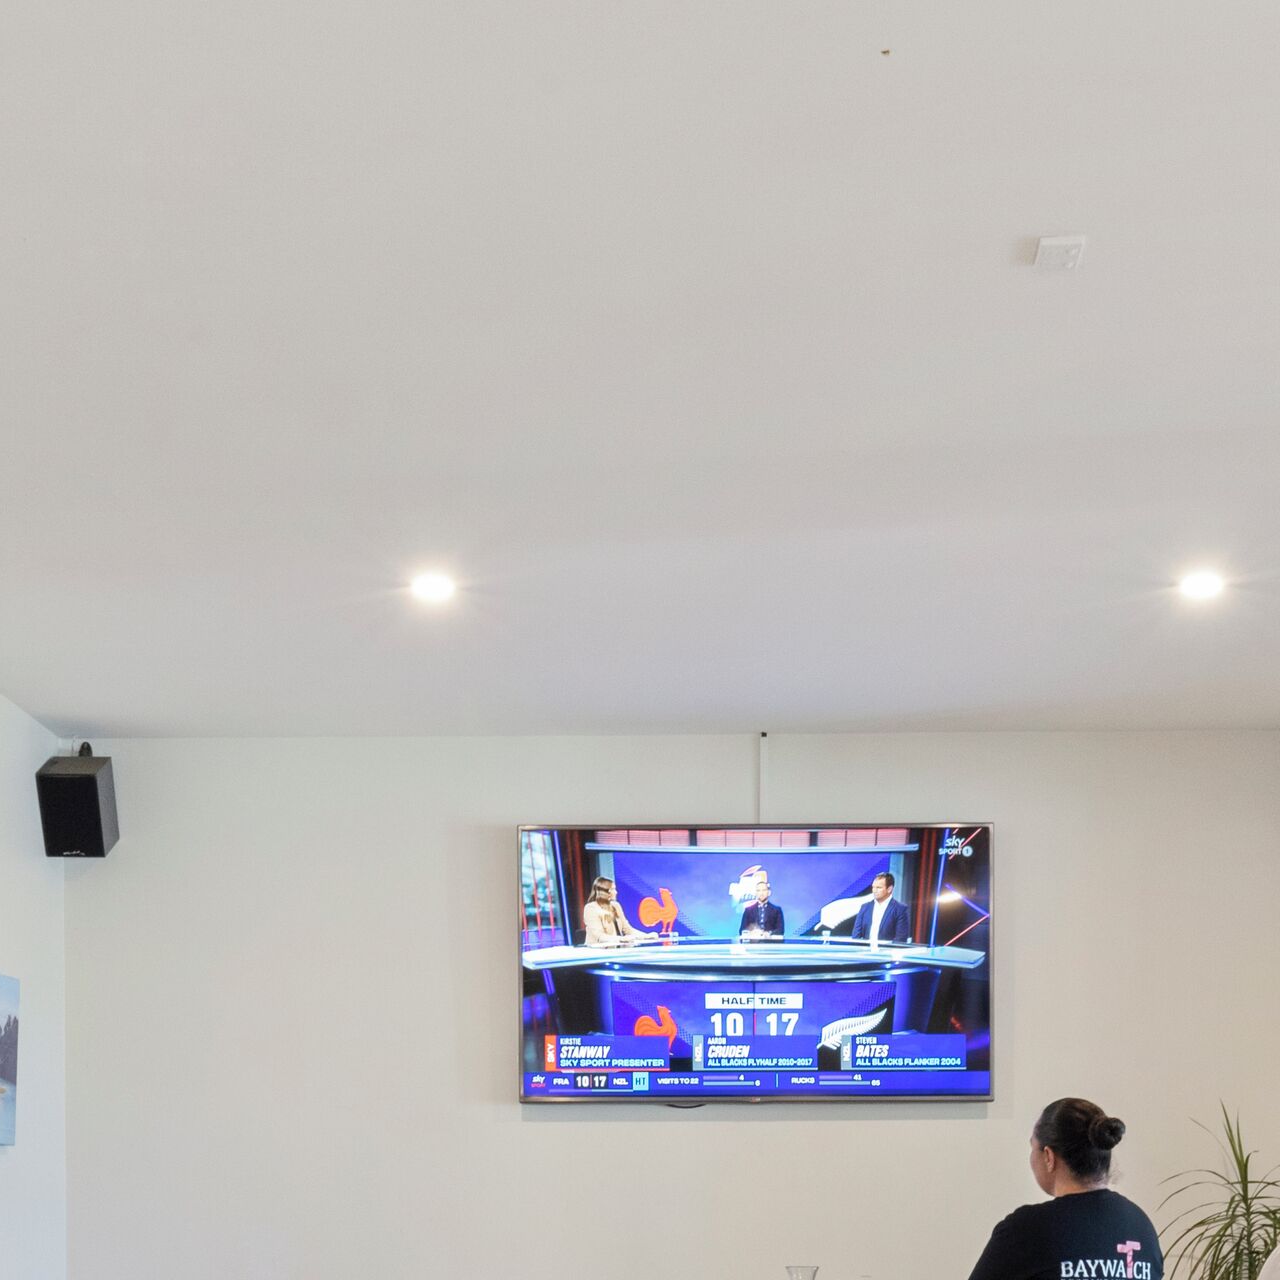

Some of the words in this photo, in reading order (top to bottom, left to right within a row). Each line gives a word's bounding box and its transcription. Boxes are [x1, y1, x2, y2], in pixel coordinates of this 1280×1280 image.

[945, 835, 965, 848] sky
[722, 997, 754, 1005] HALF
[759, 997, 787, 1005] TIME
[710, 1012, 744, 1036] 10
[766, 1012, 799, 1036] 17
[547, 1043, 555, 1063] SKY
[560, 1046, 610, 1058] STANWAY
[707, 1045, 750, 1058] CRUDEN
[856, 1045, 889, 1057] BATES
[560, 1059, 578, 1067] SKY
[580, 1059, 610, 1067] SPORT
[612, 1059, 665, 1067] PRESENTER
[707, 1058, 720, 1066] ALL
[721, 1058, 747, 1066] BLACKS
[748, 1058, 777, 1066] FLYHALF
[778, 1058, 813, 1066] 2010-2017
[856, 1058, 871, 1066] ALL
[872, 1058, 903, 1066] BLACKS
[904, 1058, 940, 1066] FLANKER
[941, 1058, 961, 1066] 2004
[532, 1074, 546, 1084] sky
[576, 1075, 590, 1087] 10
[593, 1075, 607, 1087] 17
[635, 1077, 646, 1086] HT
[1060, 1240, 1151, 1280] BAYWATCH
